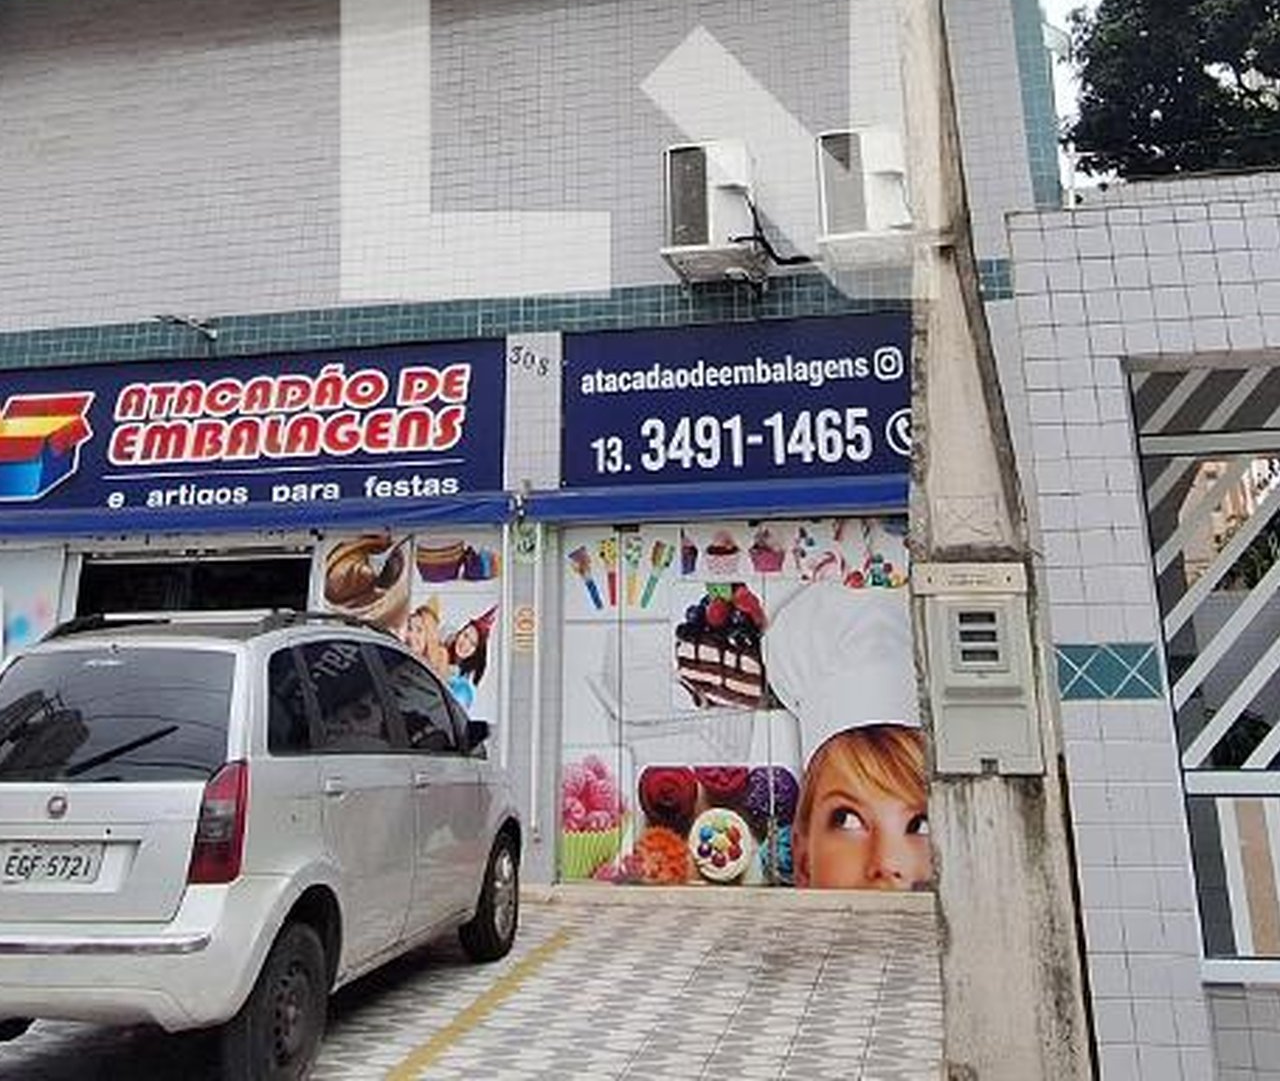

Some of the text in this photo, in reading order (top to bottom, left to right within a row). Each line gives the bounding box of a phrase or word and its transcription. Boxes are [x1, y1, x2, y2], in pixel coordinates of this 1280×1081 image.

[113, 363, 471, 420] ATACADÃO DE
[581, 354, 870, 395] atacadaodeembalagens
[108, 405, 466, 466] EMBALAGENS
[590, 407, 873, 474] 13. 3491-1465
[107, 491, 125, 509] e
[271, 480, 340, 503] para
[364, 475, 460, 499] festas
